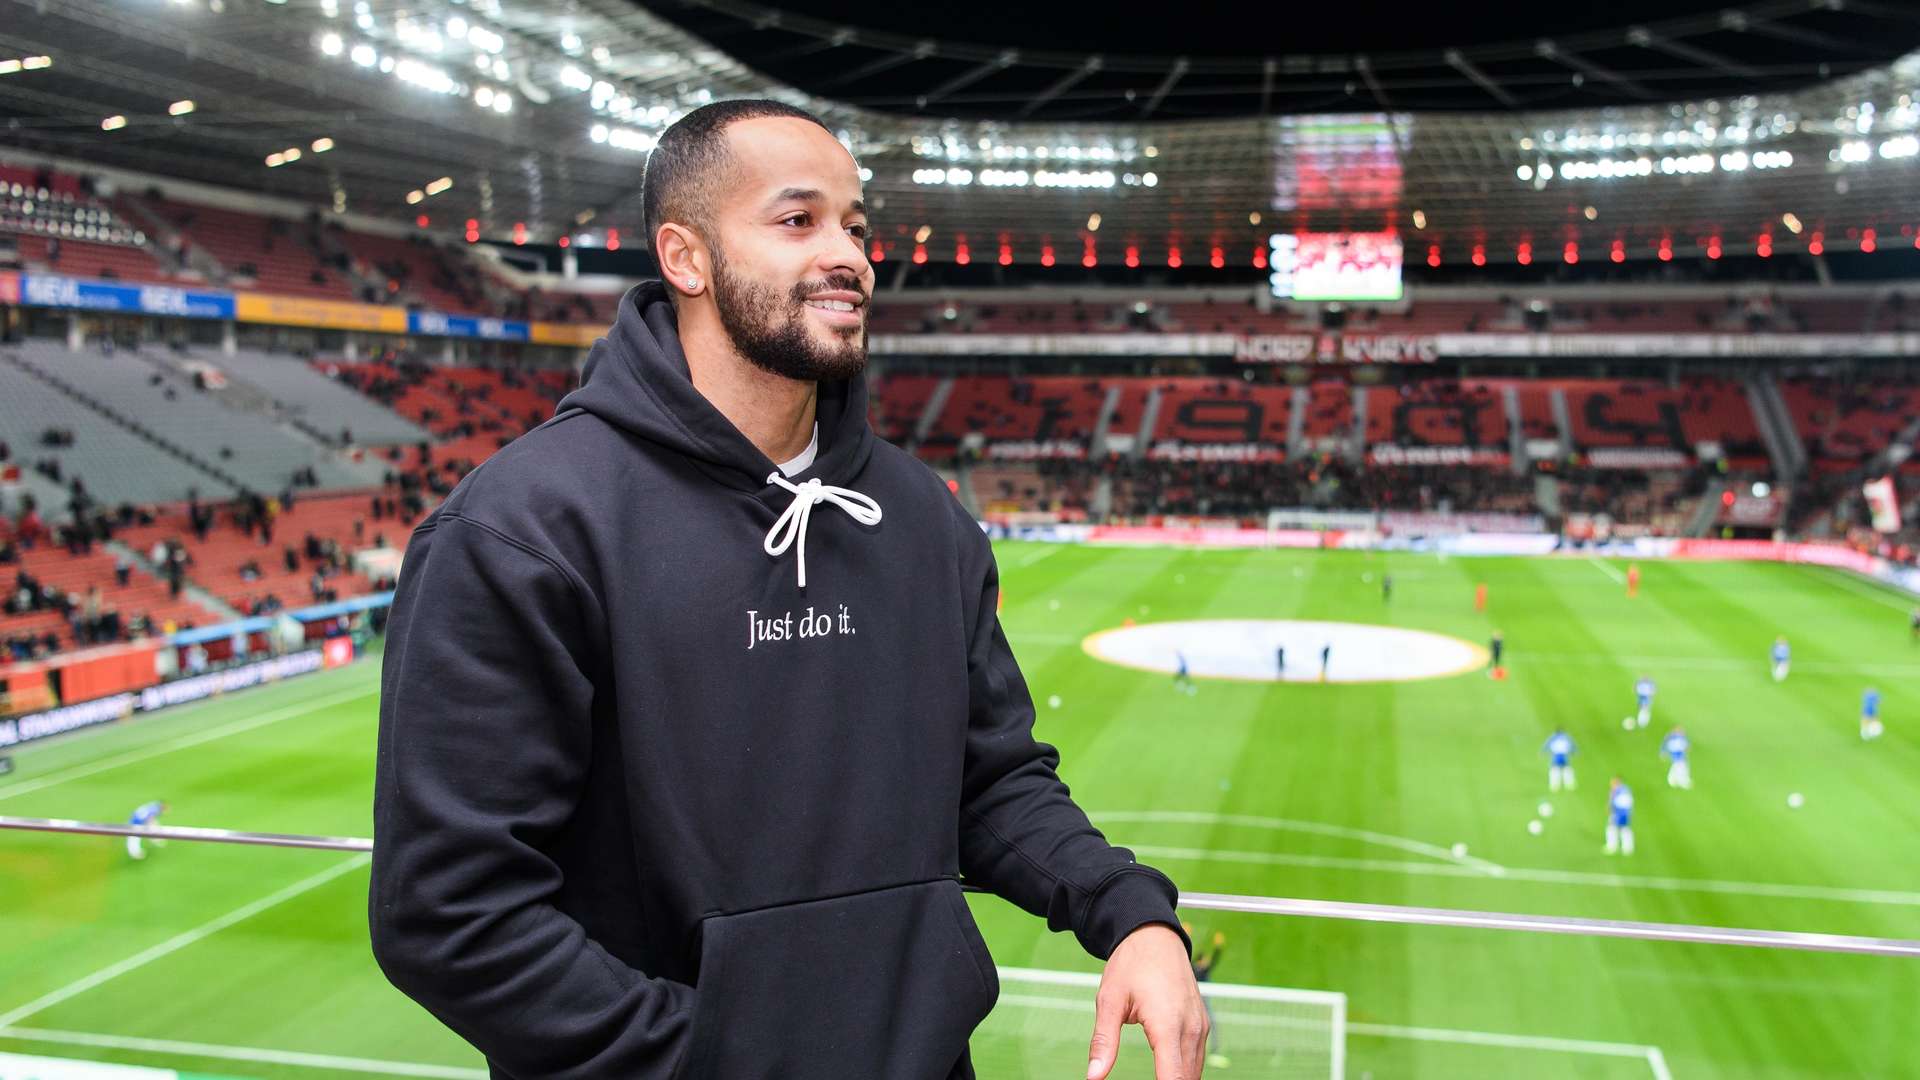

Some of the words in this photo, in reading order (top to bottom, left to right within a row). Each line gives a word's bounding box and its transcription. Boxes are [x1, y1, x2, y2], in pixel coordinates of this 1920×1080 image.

[746, 610, 794, 650] Just
[799, 606, 832, 639] do
[838, 603, 856, 635] it.
